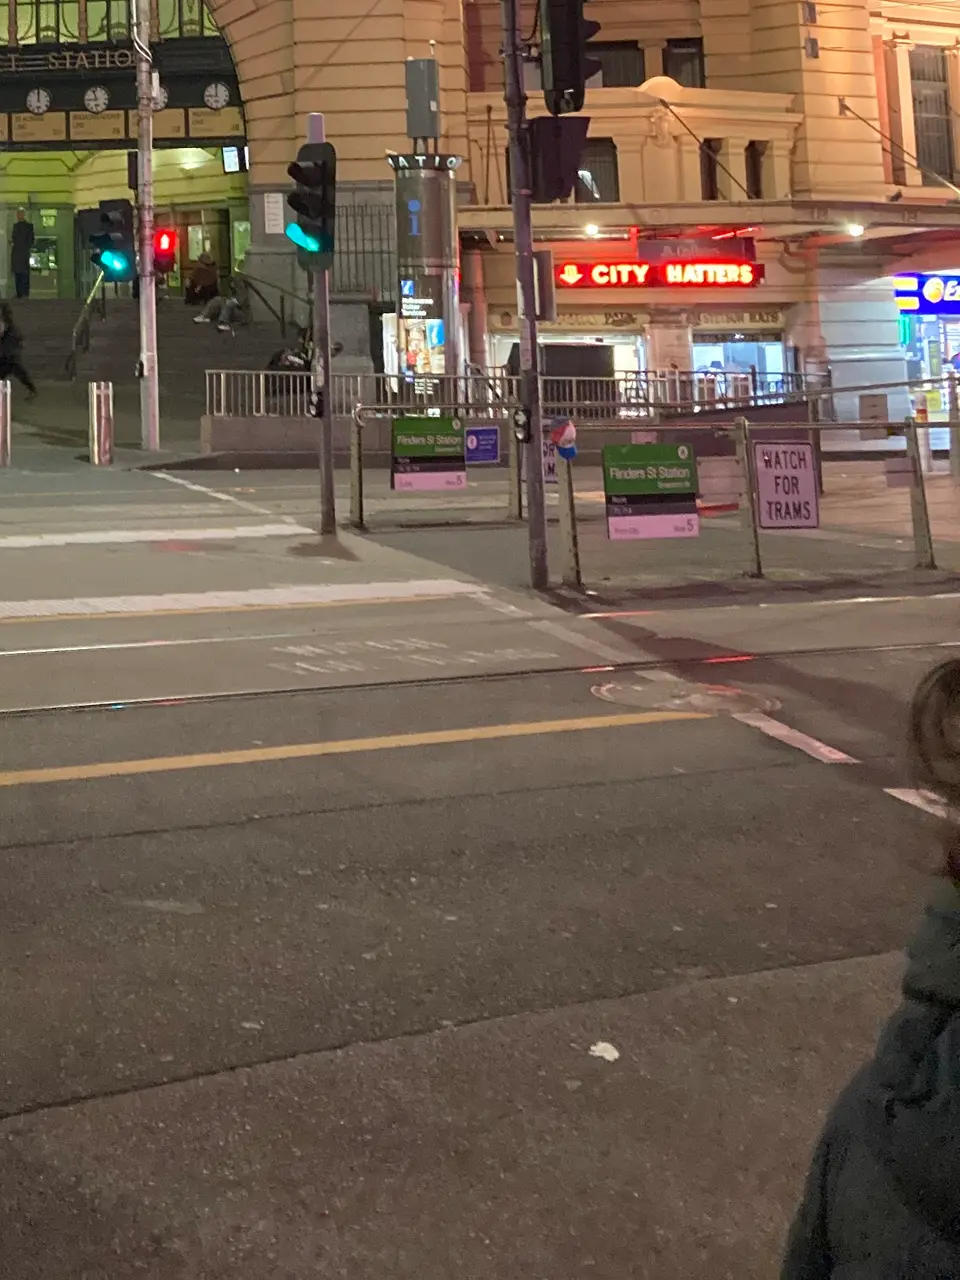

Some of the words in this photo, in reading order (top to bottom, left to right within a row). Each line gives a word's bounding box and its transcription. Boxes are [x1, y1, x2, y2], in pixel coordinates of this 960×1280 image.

[48, 49, 138, 69] STATIO
[591, 264, 649, 284] CITY
[666, 263, 753, 284] HATTERS
[397, 434, 426, 445] Flinders
[435, 435, 462, 445] Station
[762, 450, 808, 470] WATCH
[609, 467, 646, 480] Flinders
[658, 466, 690, 479] Station
[774, 476, 800, 495] FOR
[766, 501, 812, 521] TRAMS
[686, 519, 695, 532] 5
